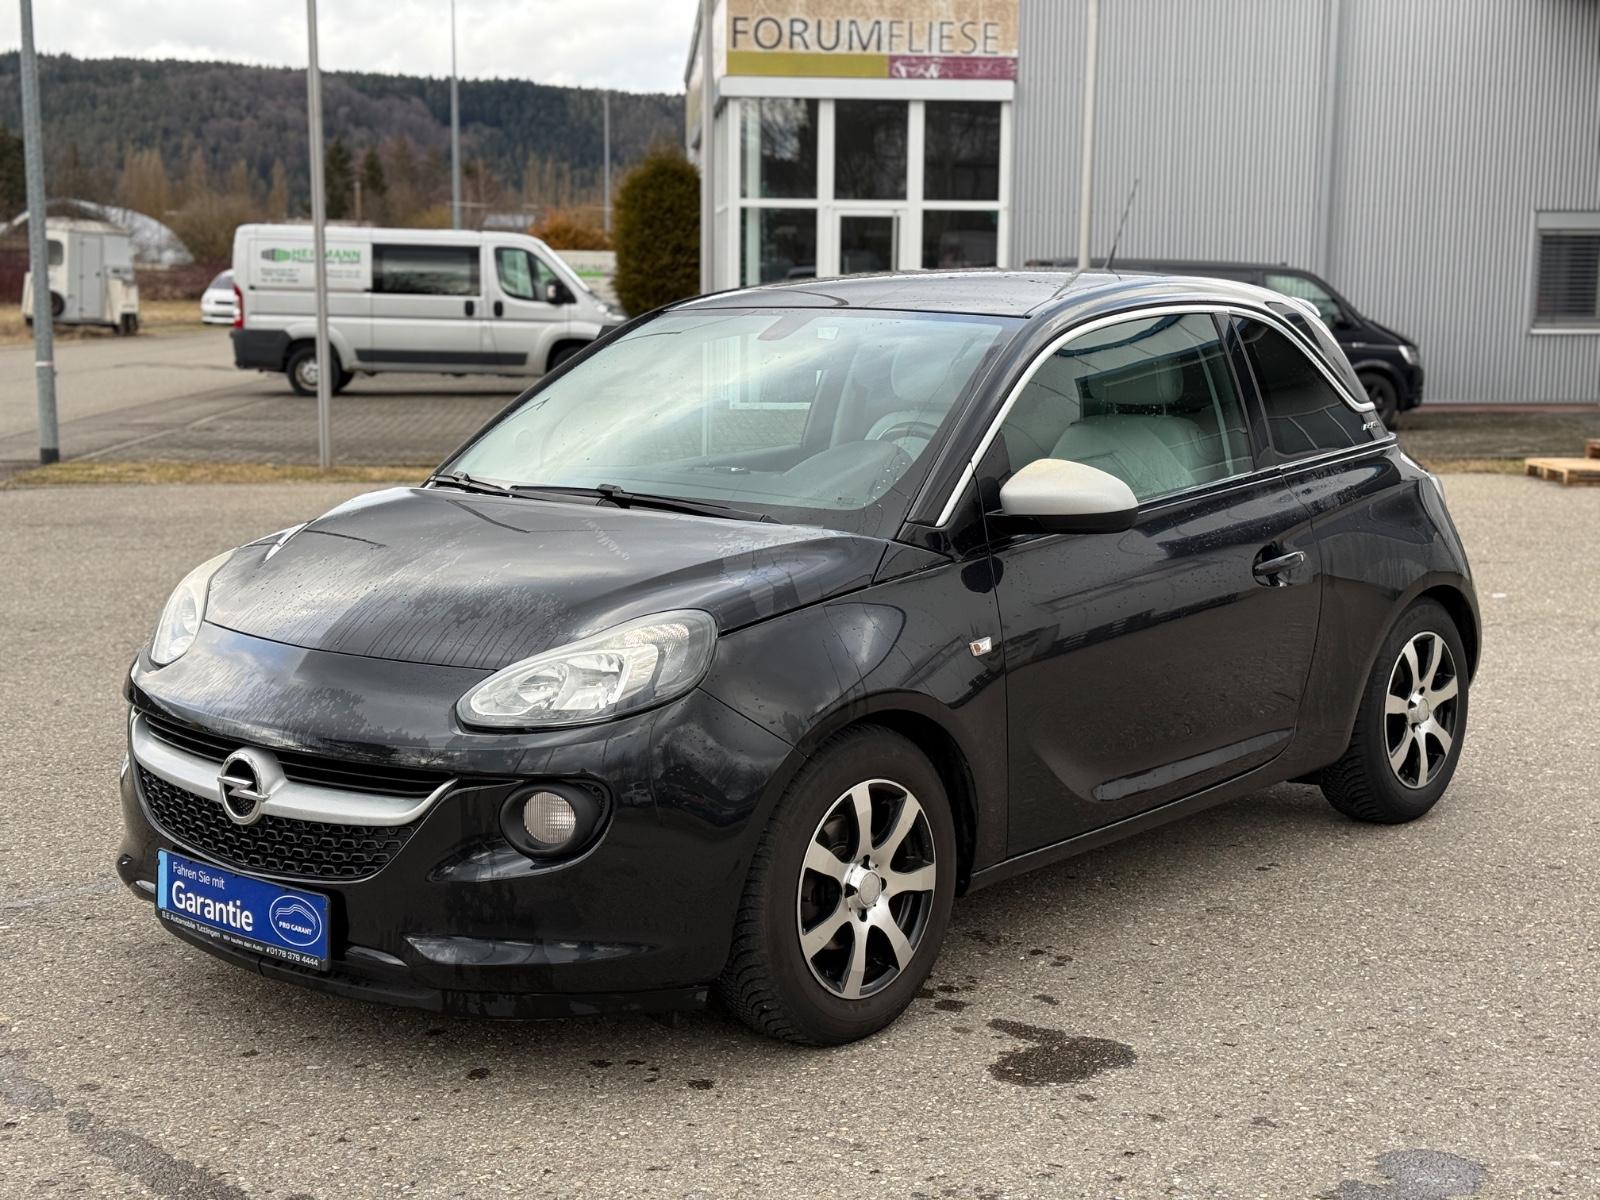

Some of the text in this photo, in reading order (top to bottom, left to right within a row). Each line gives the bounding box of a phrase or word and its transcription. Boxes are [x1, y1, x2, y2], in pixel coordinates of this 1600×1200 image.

[172, 862, 225, 890] Fahren Sie mit
[172, 880, 253, 932] Garantie
[170, 915, 196, 930] Automobile
[269, 947, 286, 959] 0178
[287, 949, 301, 962] 379
[301, 955, 319, 967] 4444
[278, 921, 312, 936] PRO GARANT
